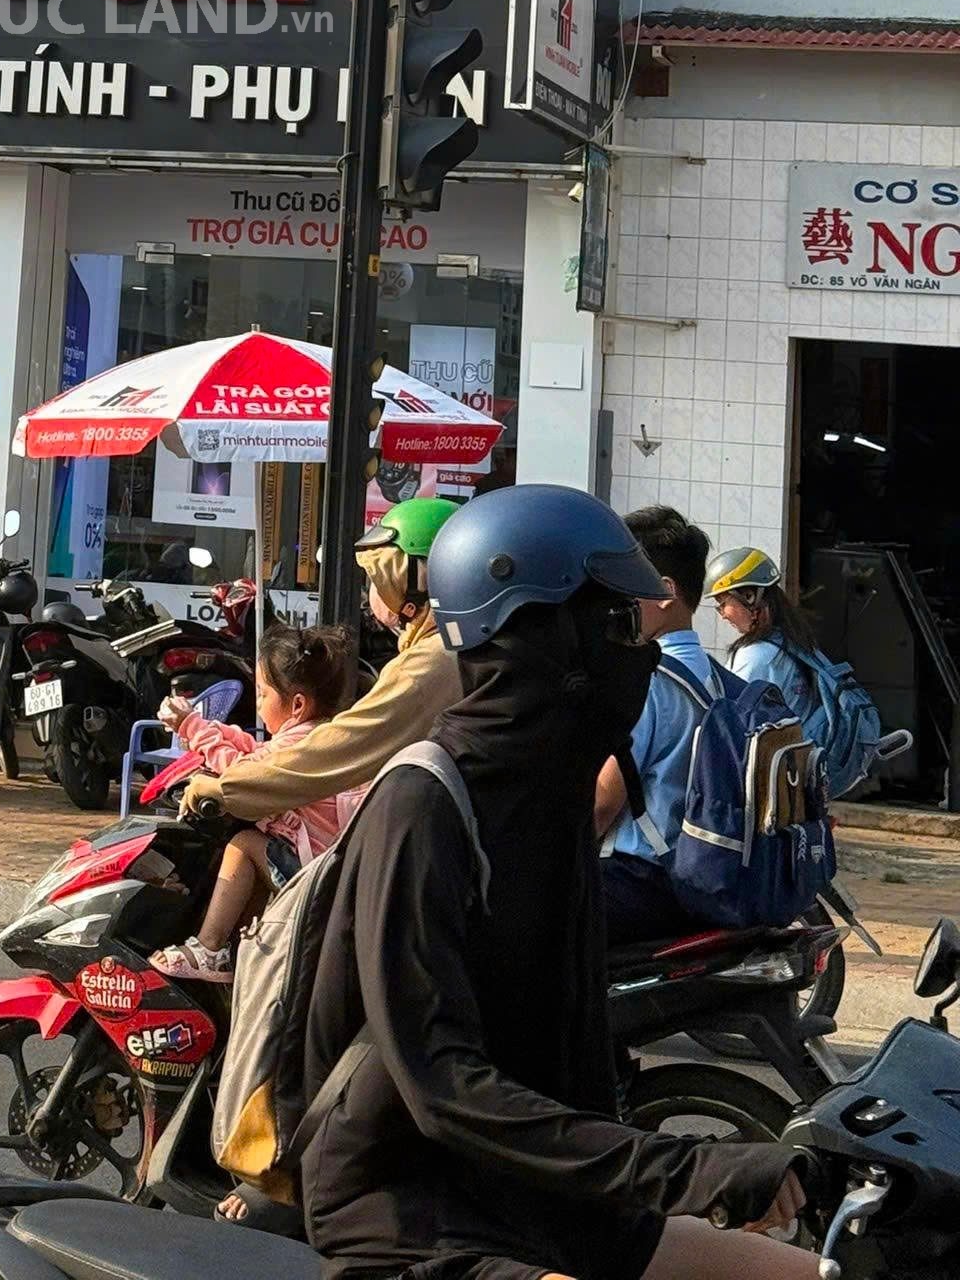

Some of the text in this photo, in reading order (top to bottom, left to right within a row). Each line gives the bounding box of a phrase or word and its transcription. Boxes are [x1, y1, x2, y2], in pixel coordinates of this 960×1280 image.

[190, 65, 313, 134] PHỤ
[230, 190, 304, 212] Thu Cũ
[854, 179, 918, 204] CƠ
[187, 217, 244, 250] TRỢ
[248, 215, 294, 245] GIÁ
[800, 207, 854, 265] 藝
[801, 274, 941, 290] ĐC: 85 VÕ VĂN NGÂN
[462, 359, 493, 385] CŨ
[273, 383, 331, 398] GÓP
[195, 399, 240, 415] LÃI
[81, 427, 115, 441] 1800
[223, 435, 330, 448] minhtuanmobile
[395, 437, 487, 451] Hotline: 1800 3355
[81, 970, 136, 993] Estrella
[85, 987, 132, 1009] Galicia
